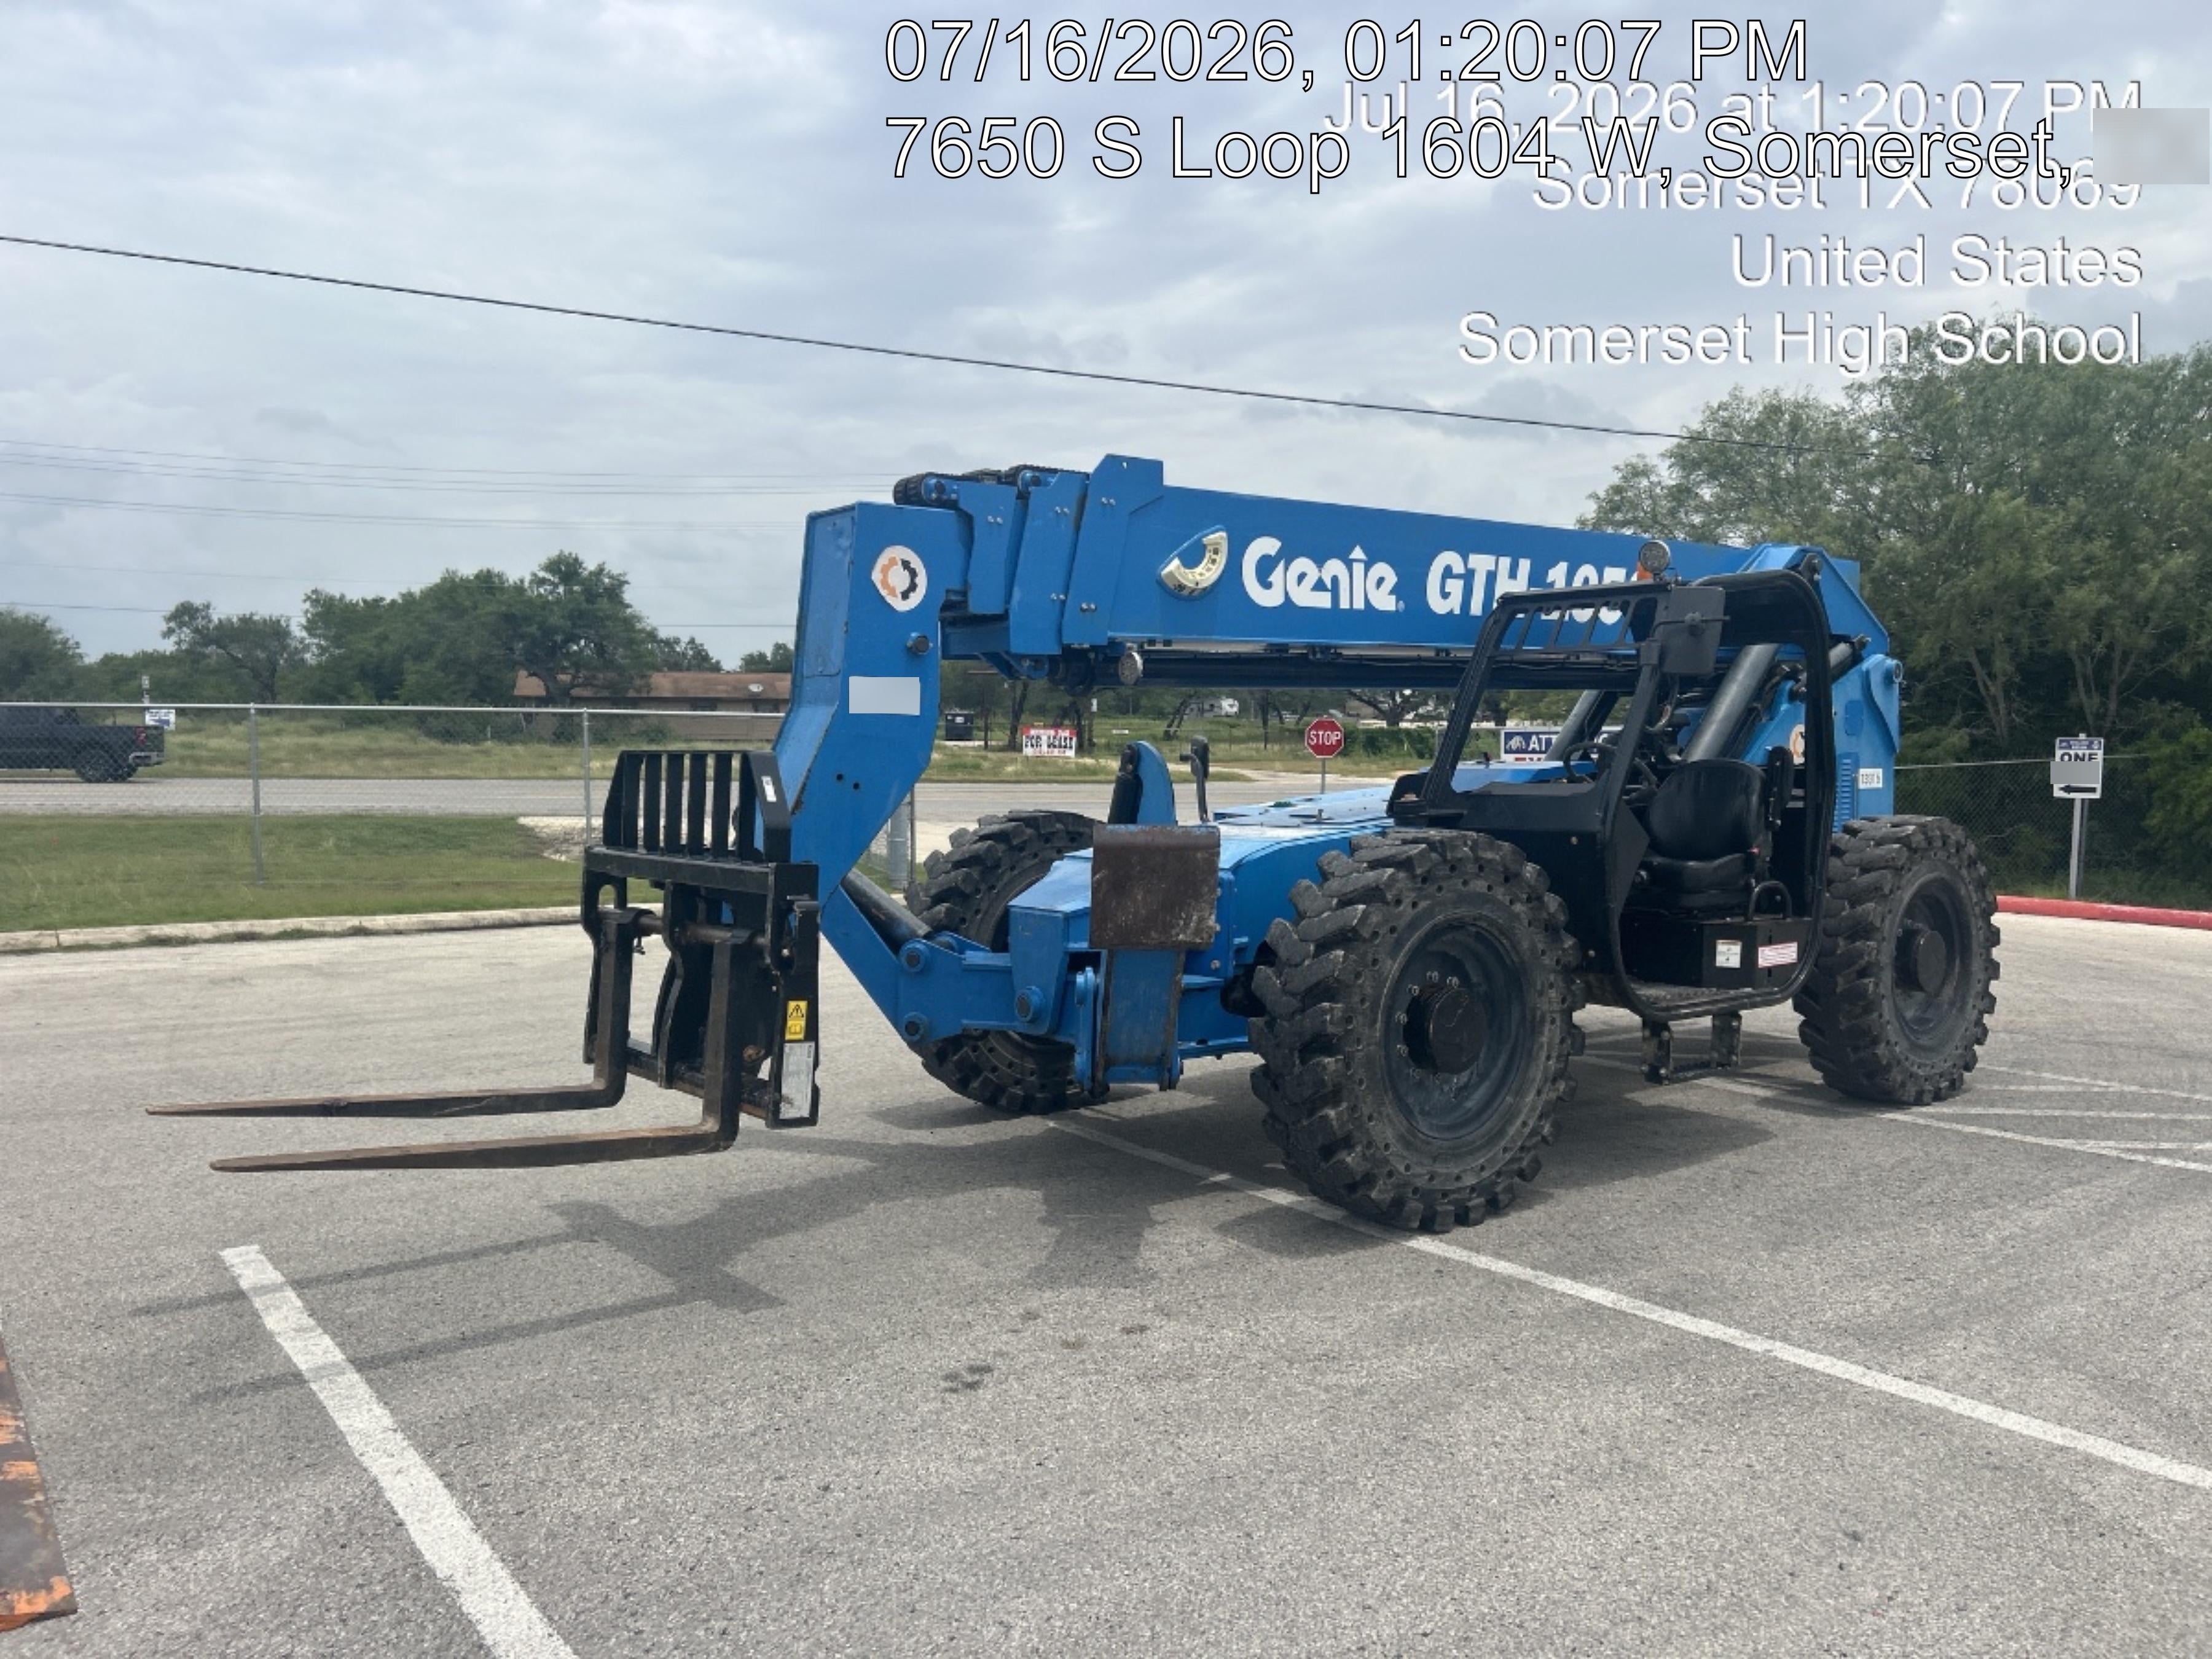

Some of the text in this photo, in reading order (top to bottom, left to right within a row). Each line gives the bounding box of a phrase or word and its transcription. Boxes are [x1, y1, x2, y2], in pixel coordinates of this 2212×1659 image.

[1241, 536, 1639, 626] Genie GTH-105
[1308, 729, 1341, 746] STOP
